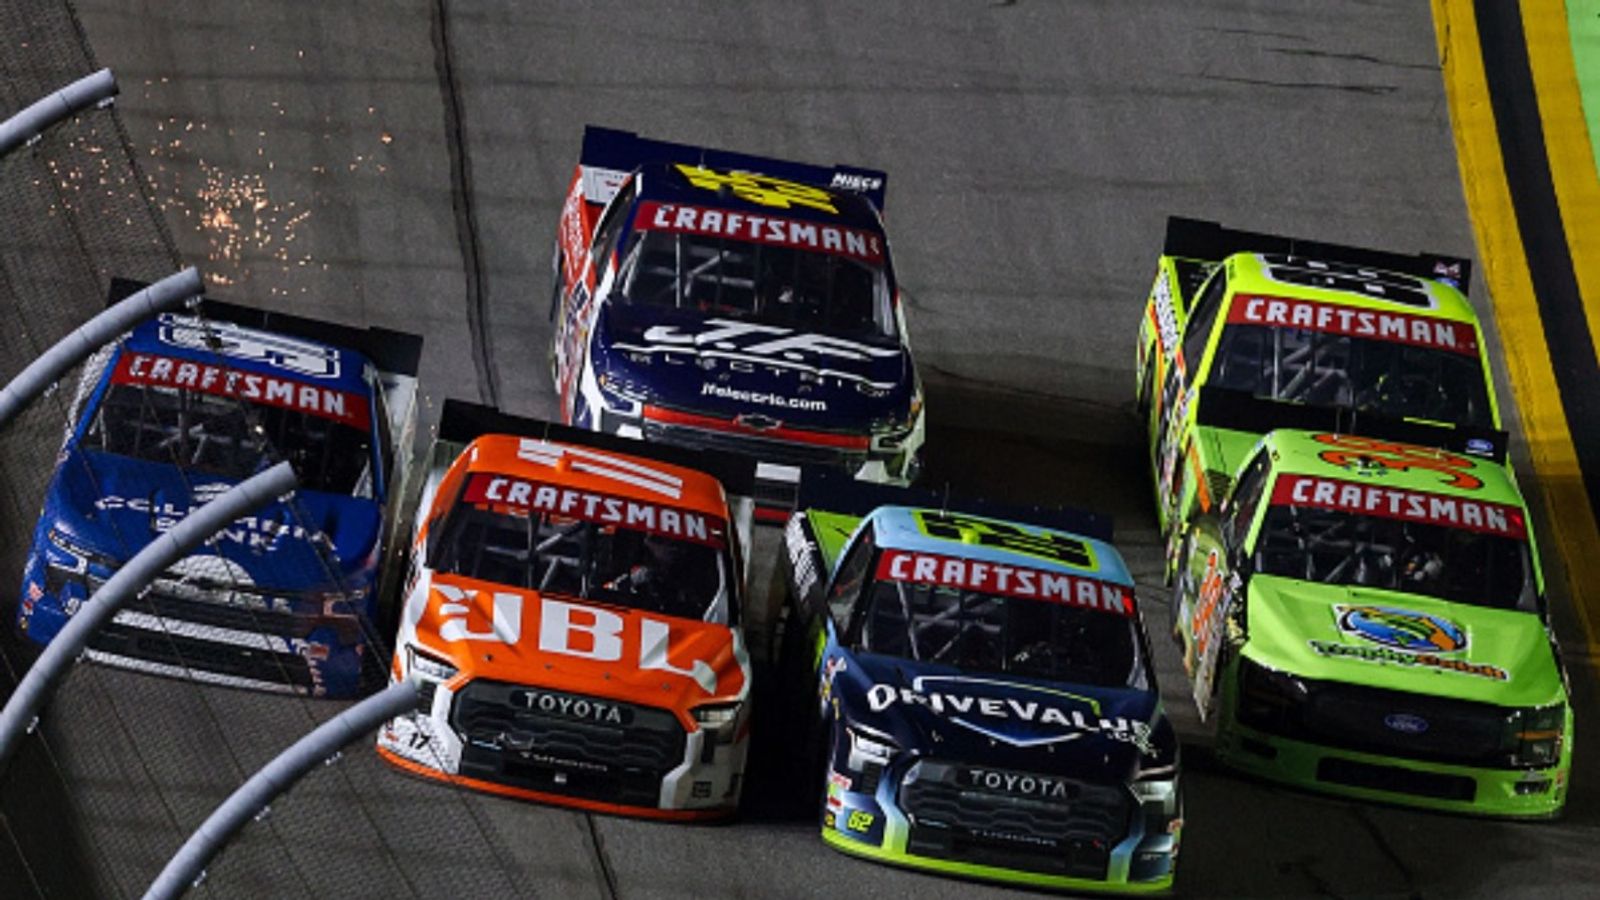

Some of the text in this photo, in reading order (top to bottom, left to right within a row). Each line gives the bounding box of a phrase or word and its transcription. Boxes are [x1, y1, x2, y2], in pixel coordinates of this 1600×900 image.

[653, 204, 866, 257] CRAFTSMAN
[1244, 298, 1457, 348] CRAFTSMAN
[128, 355, 347, 417] CRAFTSMAN
[701, 382, 827, 411] jfelectric.com
[486, 478, 708, 542] CRAFTSMAN
[1291, 478, 1509, 533] CRAFTSMAN
[889, 553, 1126, 614] CRAFTSMAN
[439, 588, 717, 695] JBL
[523, 691, 623, 724] TOYOTA
[408, 732, 430, 750] 17
[968, 769, 1068, 798] TOYOTA
[847, 811, 874, 832] 62
